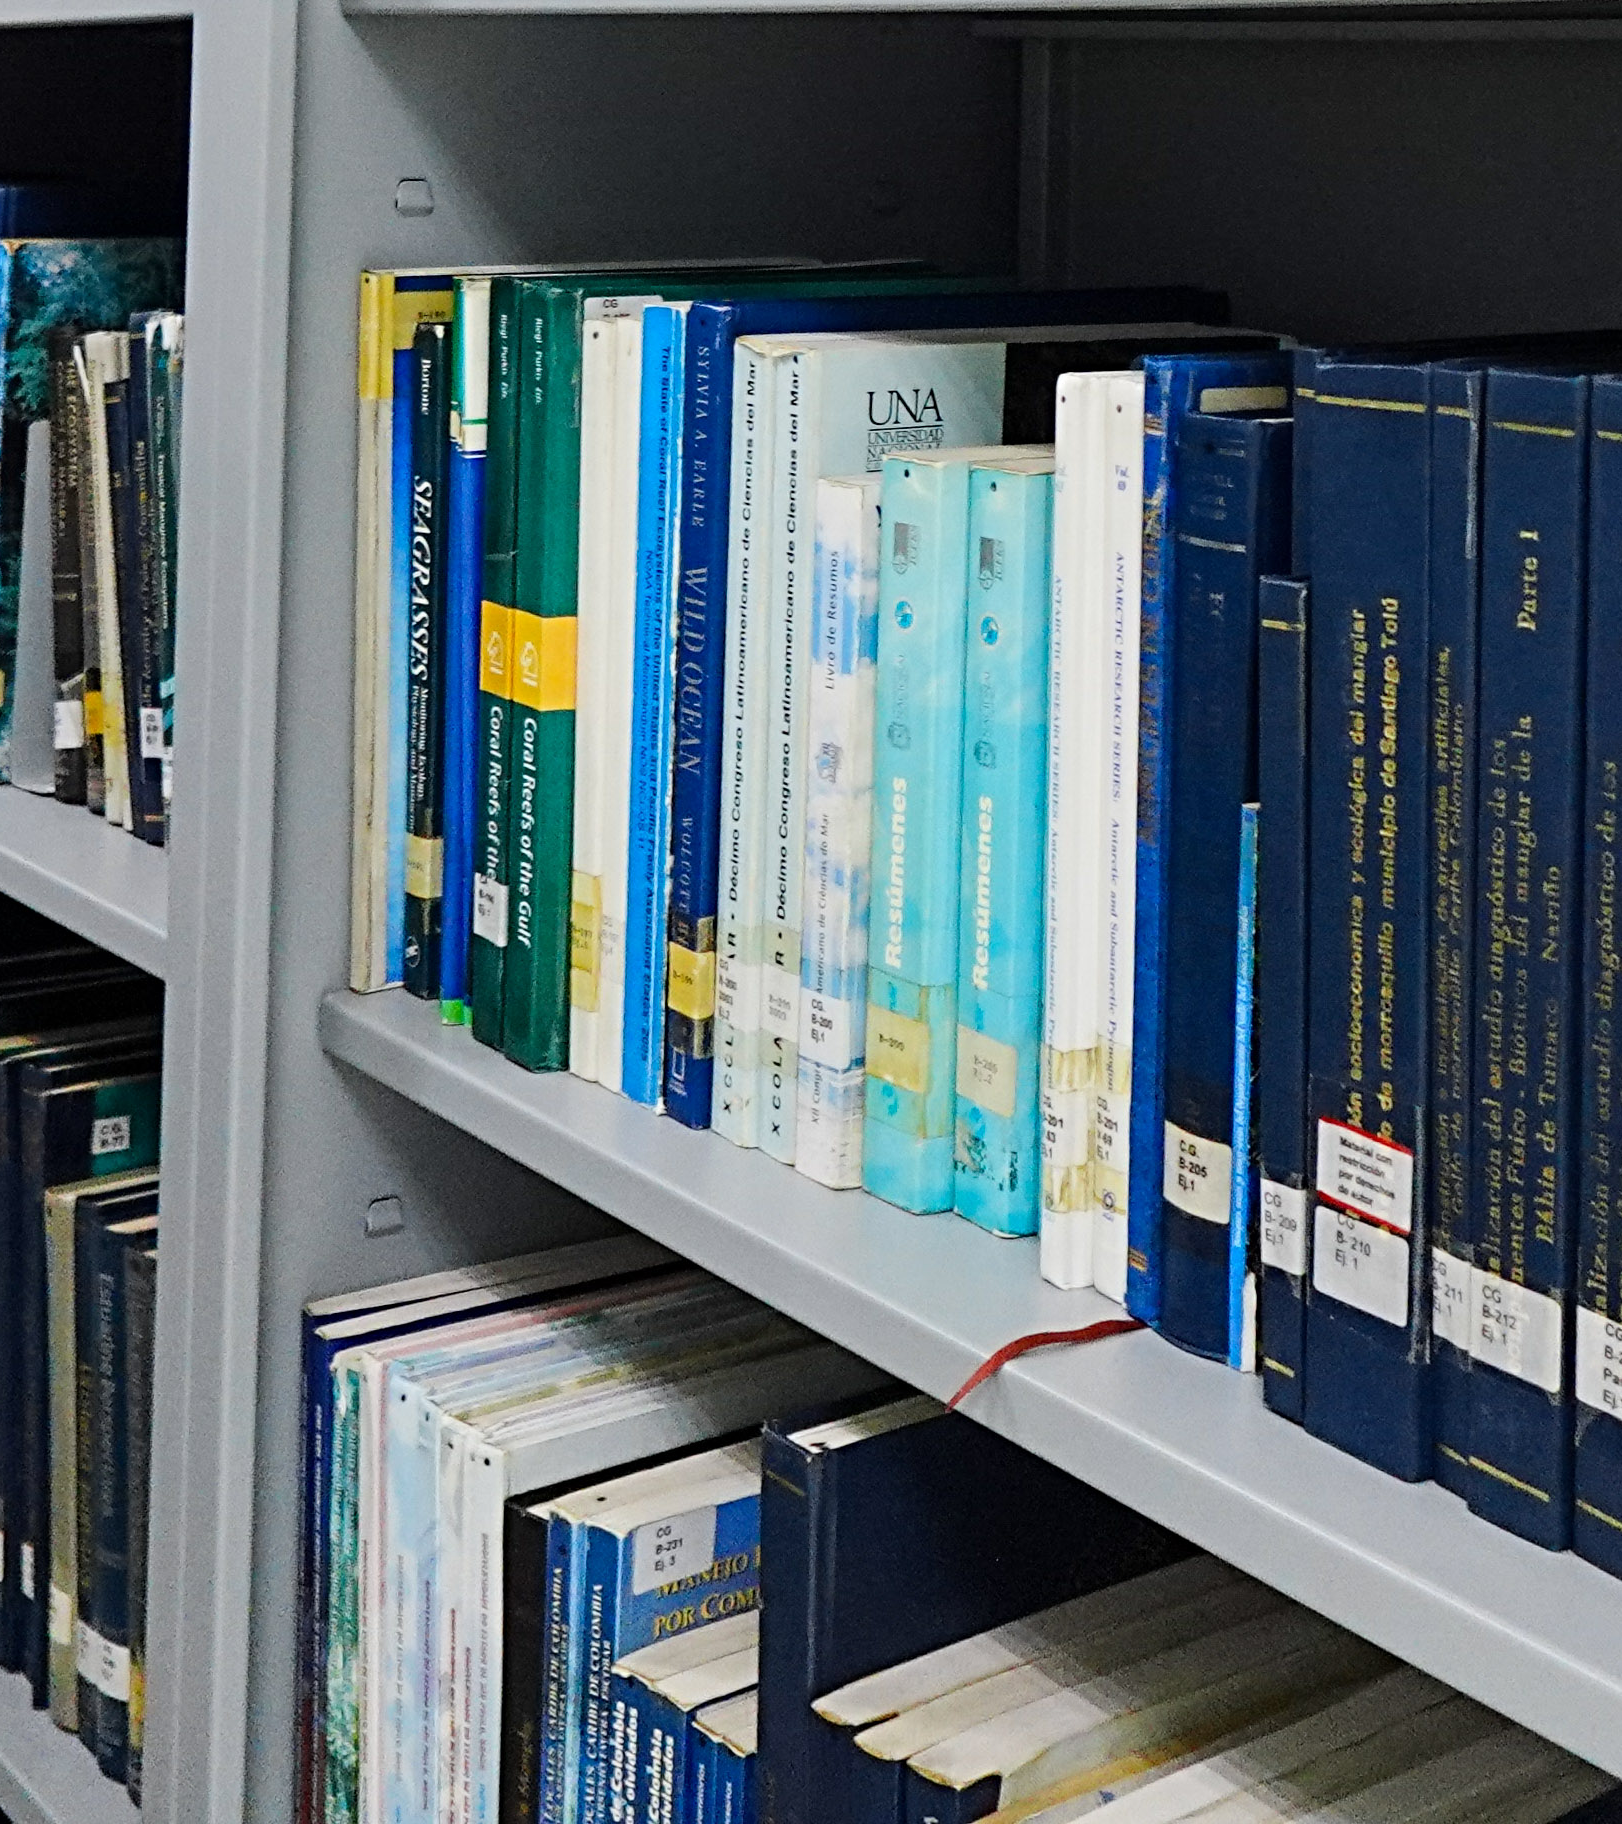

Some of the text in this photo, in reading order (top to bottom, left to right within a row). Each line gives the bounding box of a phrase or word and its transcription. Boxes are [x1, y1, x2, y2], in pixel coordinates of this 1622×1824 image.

[420, 358, 433, 416] Bortone
[866, 388, 945, 427] UNA
[866, 430, 946, 445] UNIVERSIDAD
[157, 453, 167, 497] Tropical
[157, 500, 168, 556] Mangrove
[409, 475, 434, 681] SEAGRASSES
[677, 566, 711, 776] WILD OCEAN
[484, 706, 505, 881] Coral Reefs of the
[513, 716, 540, 947] Coral Reefs of the Gulf
[884, 777, 908, 969] Resúmenes
[971, 795, 996, 990] Resúmenes
[1263, 1191, 1283, 1209] CG
[1481, 1285, 1503, 1304] CG
[1481, 1305, 1519, 1331] B-212
[657, 1525, 672, 1538] CG
[552, 1566, 564, 1639] COLOMBIA
[652, 1601, 697, 1638] POR
[548, 1656, 560, 1678] DE
[585, 1584, 604, 1759] CARIBE DE COLOMBIA
[609, 1701, 627, 1822] de Colombia
[623, 1706, 639, 1801] olvidados
